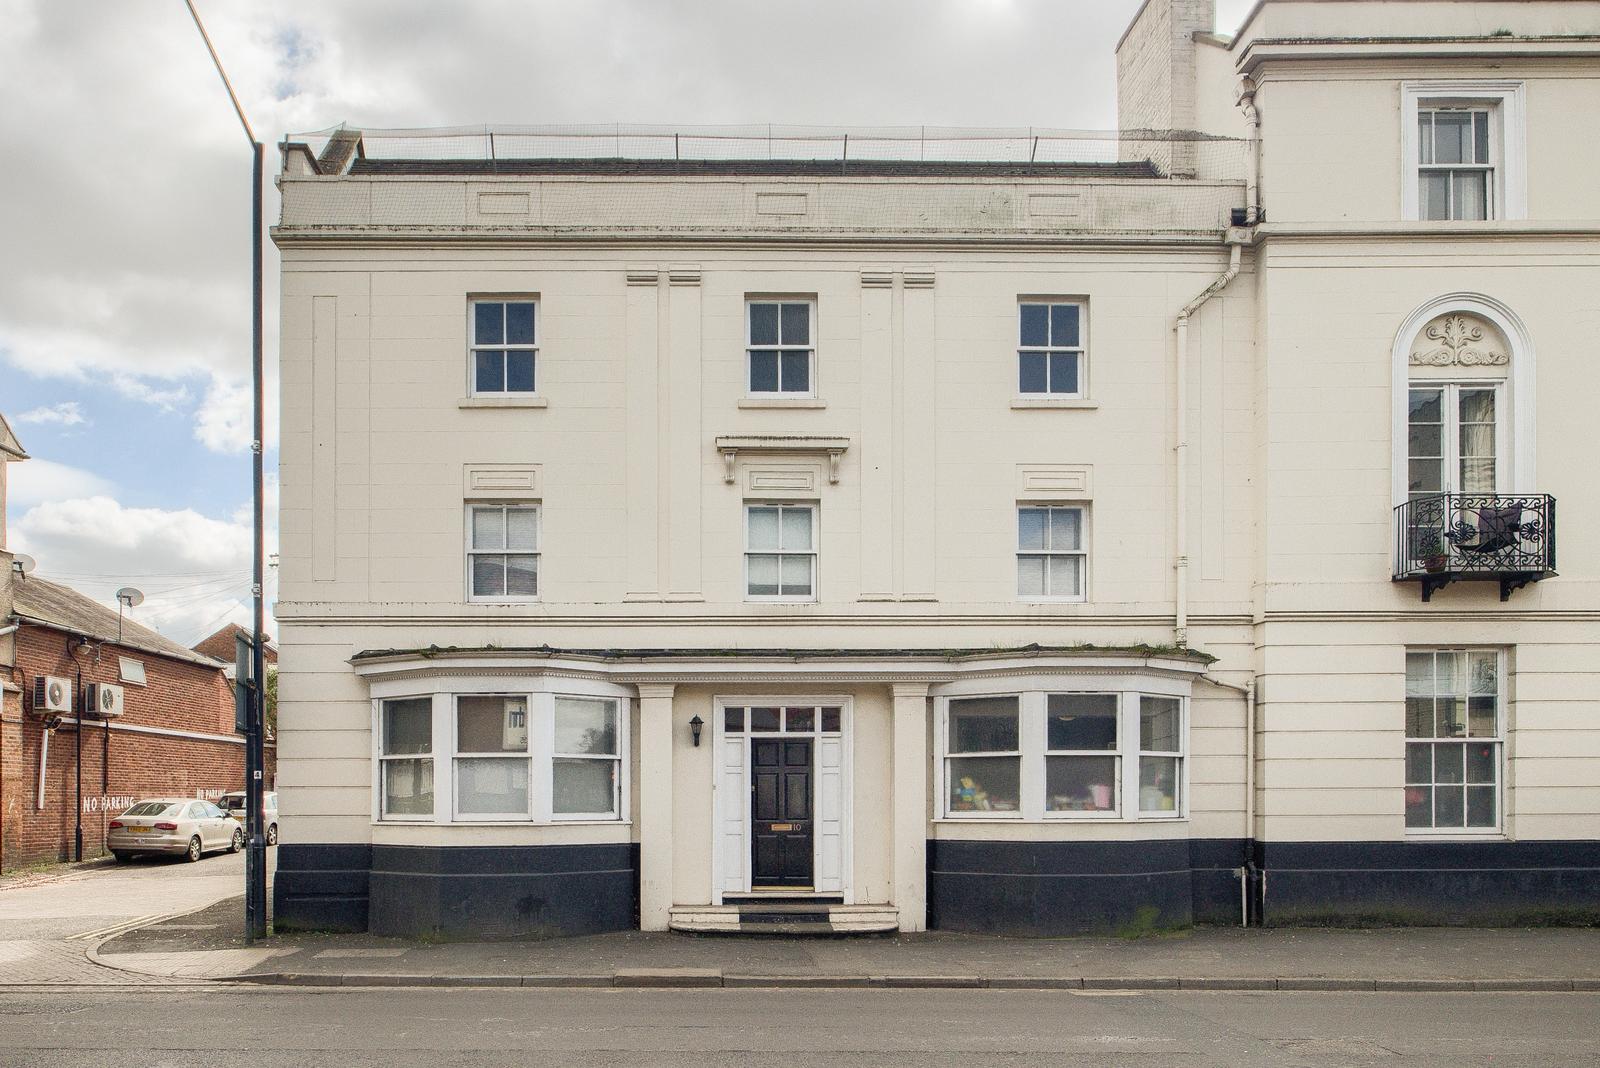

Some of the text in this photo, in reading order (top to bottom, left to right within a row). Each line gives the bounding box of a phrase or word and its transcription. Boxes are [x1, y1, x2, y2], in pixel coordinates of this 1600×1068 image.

[83, 796, 134, 812] NO PARKING
[793, 823, 802, 831] 10
